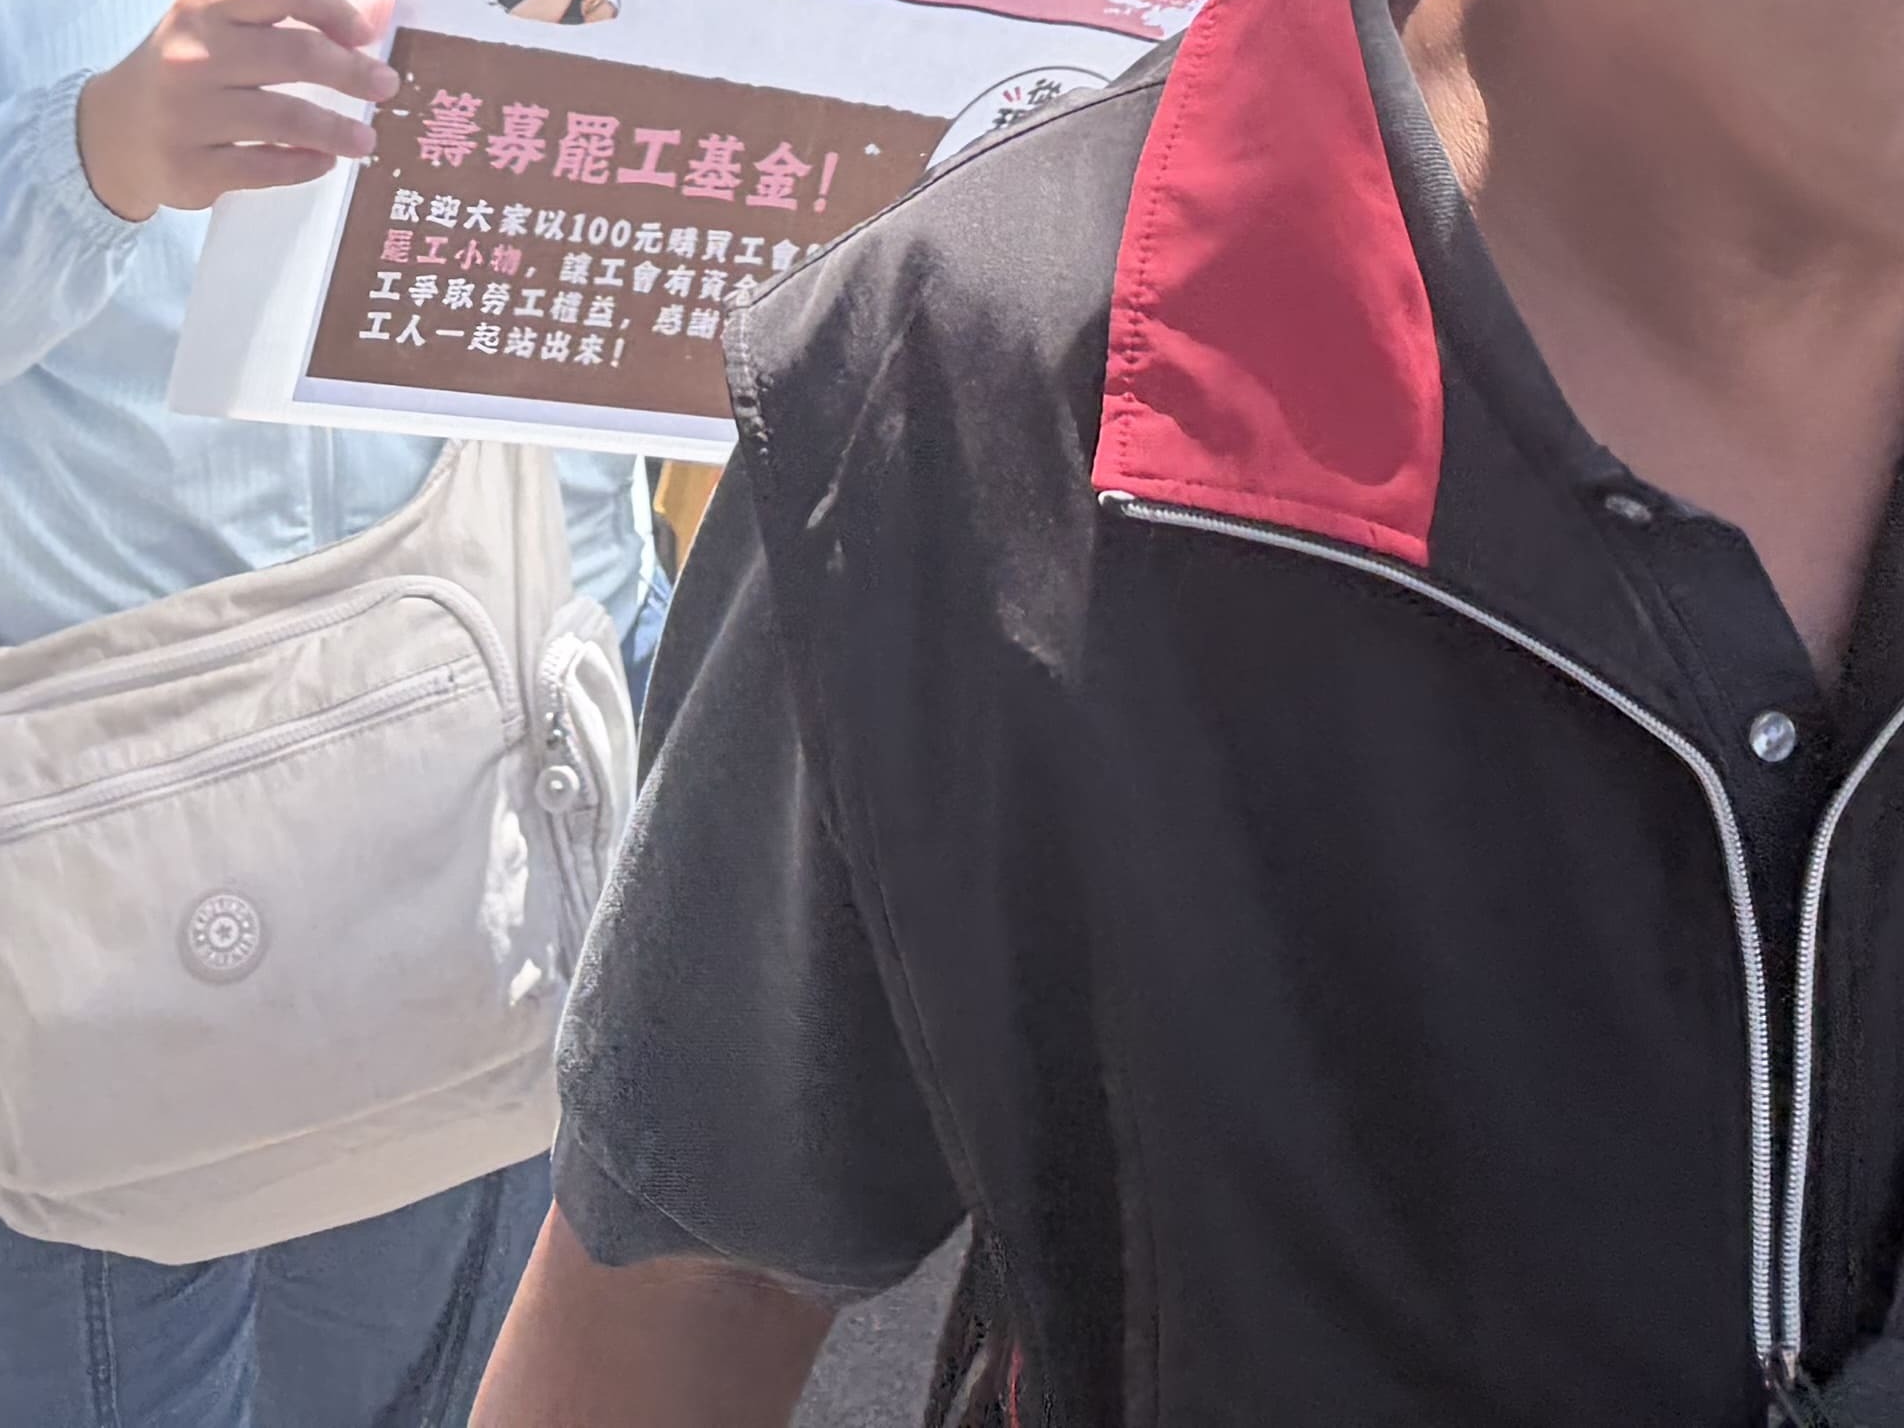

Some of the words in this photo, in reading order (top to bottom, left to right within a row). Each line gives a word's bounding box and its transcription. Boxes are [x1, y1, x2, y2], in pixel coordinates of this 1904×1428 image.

[416, 88, 840, 215] 籌募罷工基金！
[388, 188, 822, 272] 歡迎大家以100元購買工會
[358, 310, 627, 369] 工人一起站出來！
